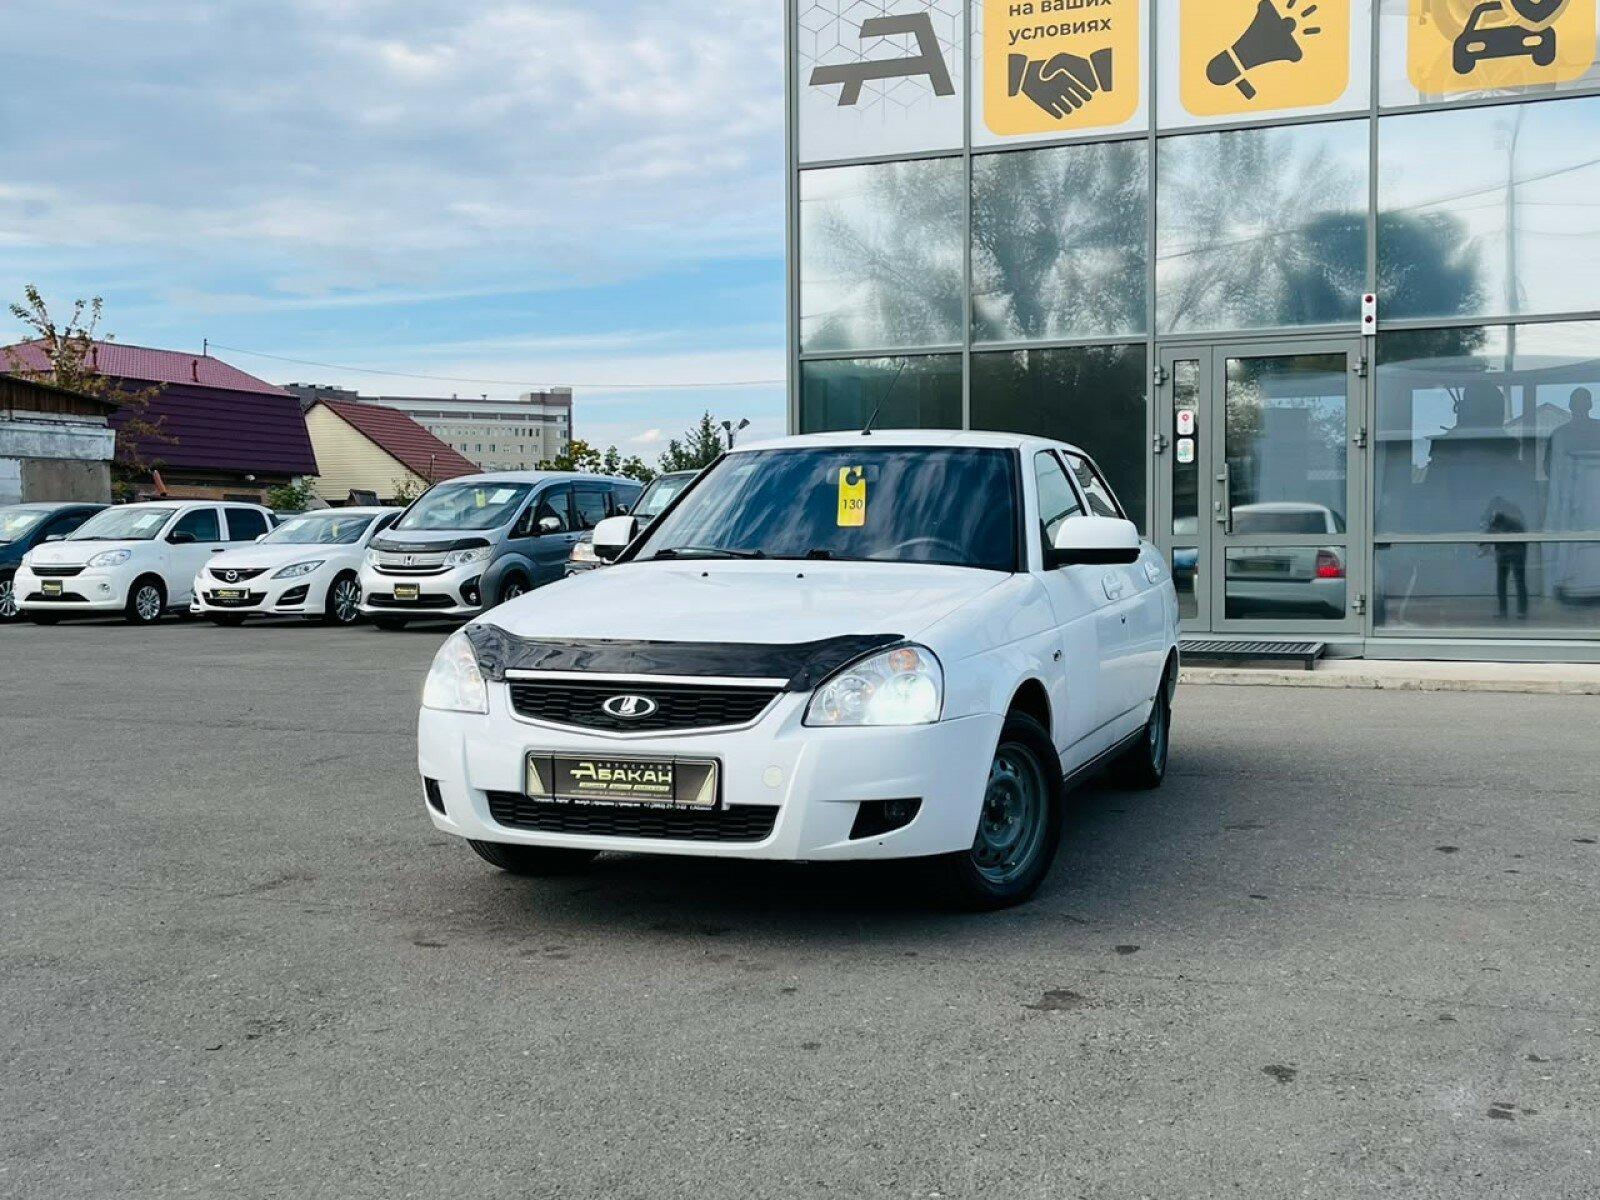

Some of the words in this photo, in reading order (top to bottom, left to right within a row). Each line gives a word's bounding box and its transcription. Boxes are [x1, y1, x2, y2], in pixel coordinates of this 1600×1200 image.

[1009, 3, 1034, 17] на
[1008, 18, 1112, 46] условиях
[843, 499, 864, 510] 130
